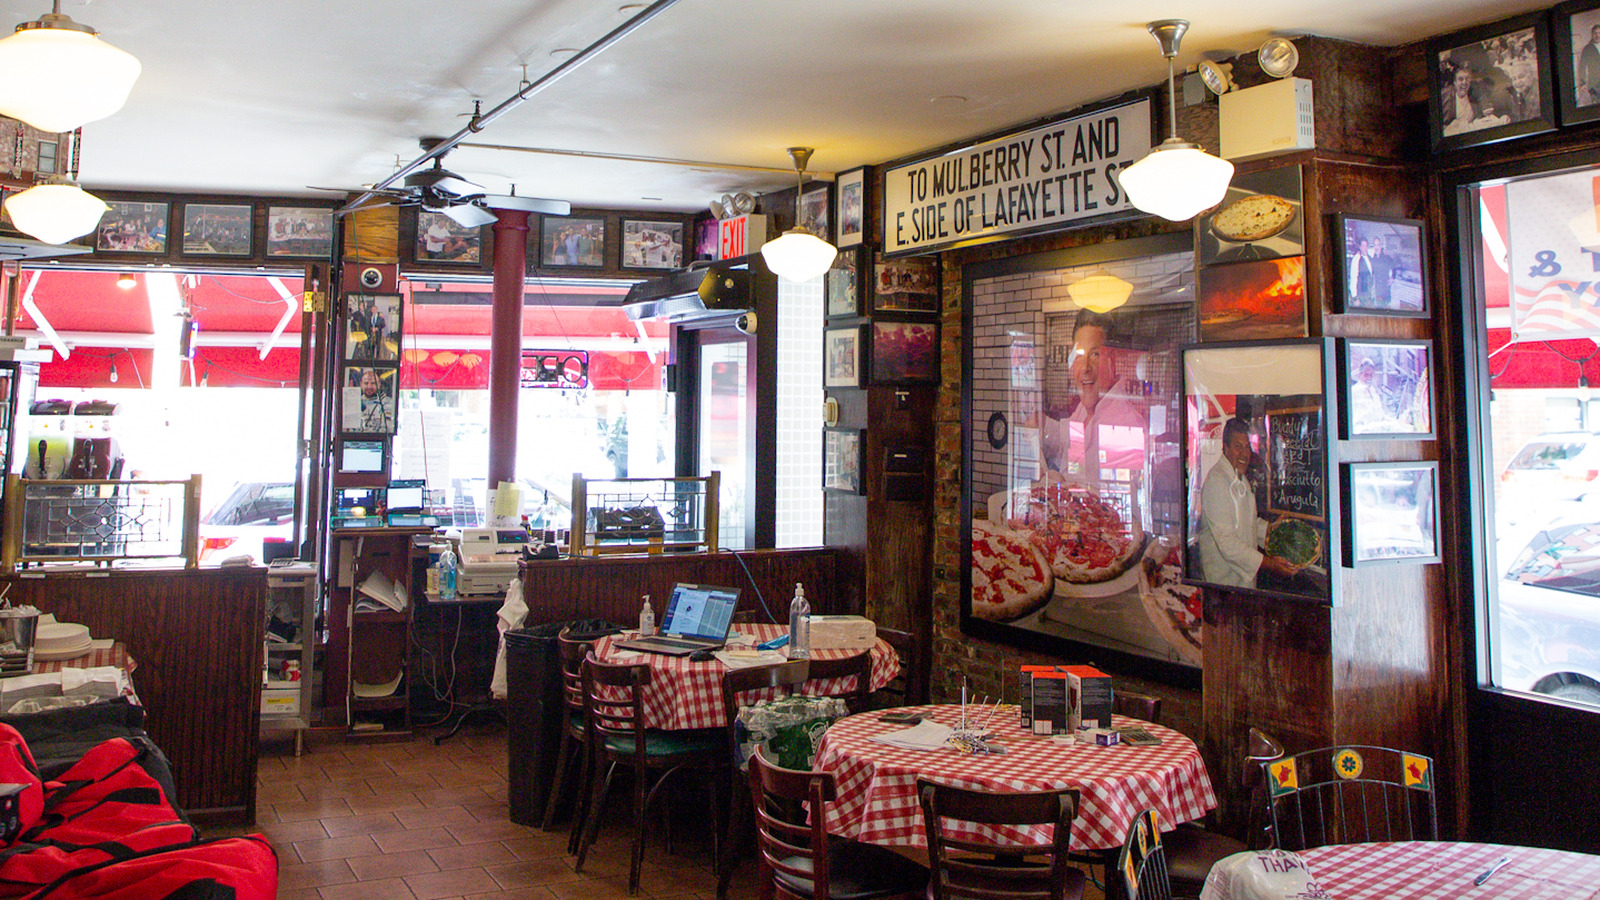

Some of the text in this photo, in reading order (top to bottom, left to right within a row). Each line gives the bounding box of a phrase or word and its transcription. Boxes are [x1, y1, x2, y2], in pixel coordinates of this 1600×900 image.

[15, 136, 23, 167] PIZZA
[908, 116, 1120, 203] TO MULBERRY ST. AND
[896, 211, 910, 246] E.
[911, 202, 948, 243] SIDE
[953, 195, 976, 234] OF
[982, 168, 1098, 229] LAFAYETTE
[722, 216, 746, 260] EXIT
[1279, 488, 1319, 510] Arugula
